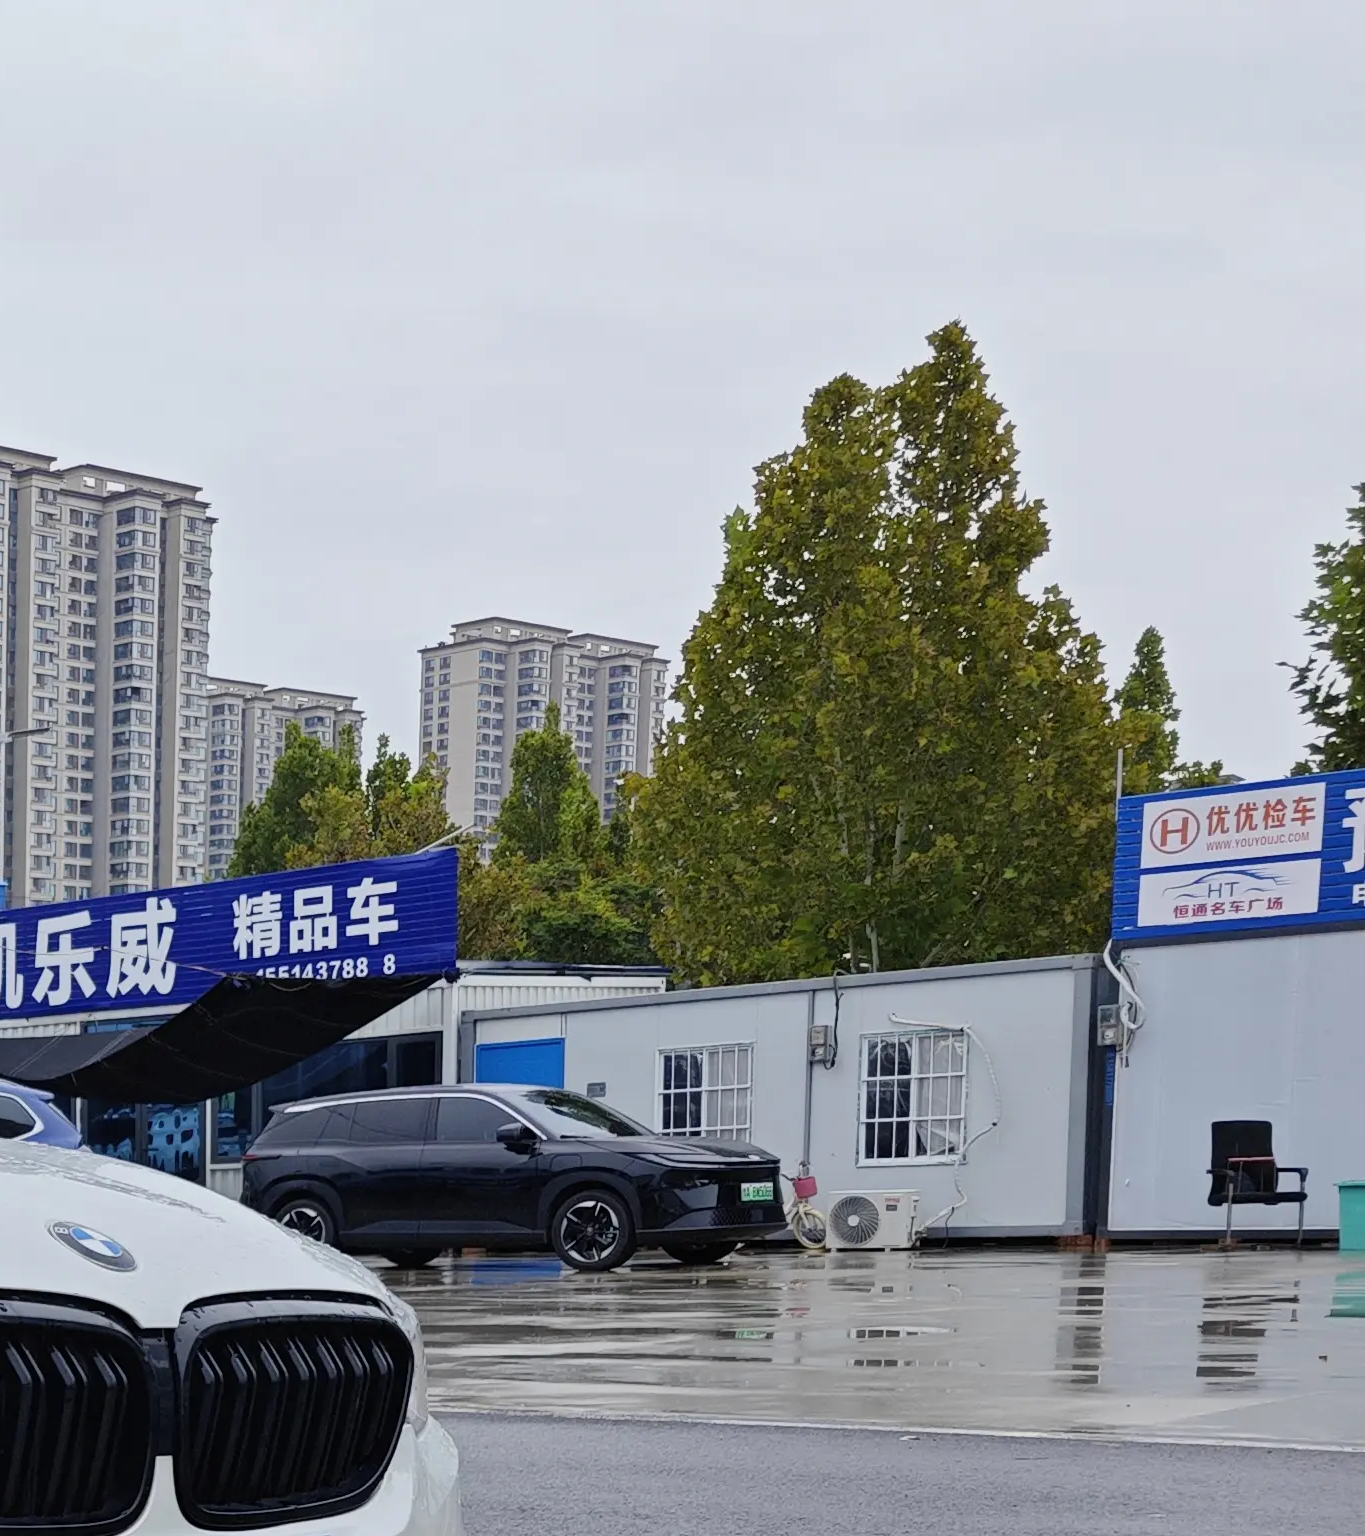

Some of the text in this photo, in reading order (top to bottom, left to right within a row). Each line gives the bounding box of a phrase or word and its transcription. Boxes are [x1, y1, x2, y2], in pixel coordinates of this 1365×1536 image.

[1206, 796, 1317, 836] 优优检车
[1206, 831, 1310, 852] WWW.YOUYOUJC.COM
[1207, 881, 1240, 899] HT
[232, 876, 400, 961] 精品车
[1173, 896, 1284, 919] 恒通名车广场
